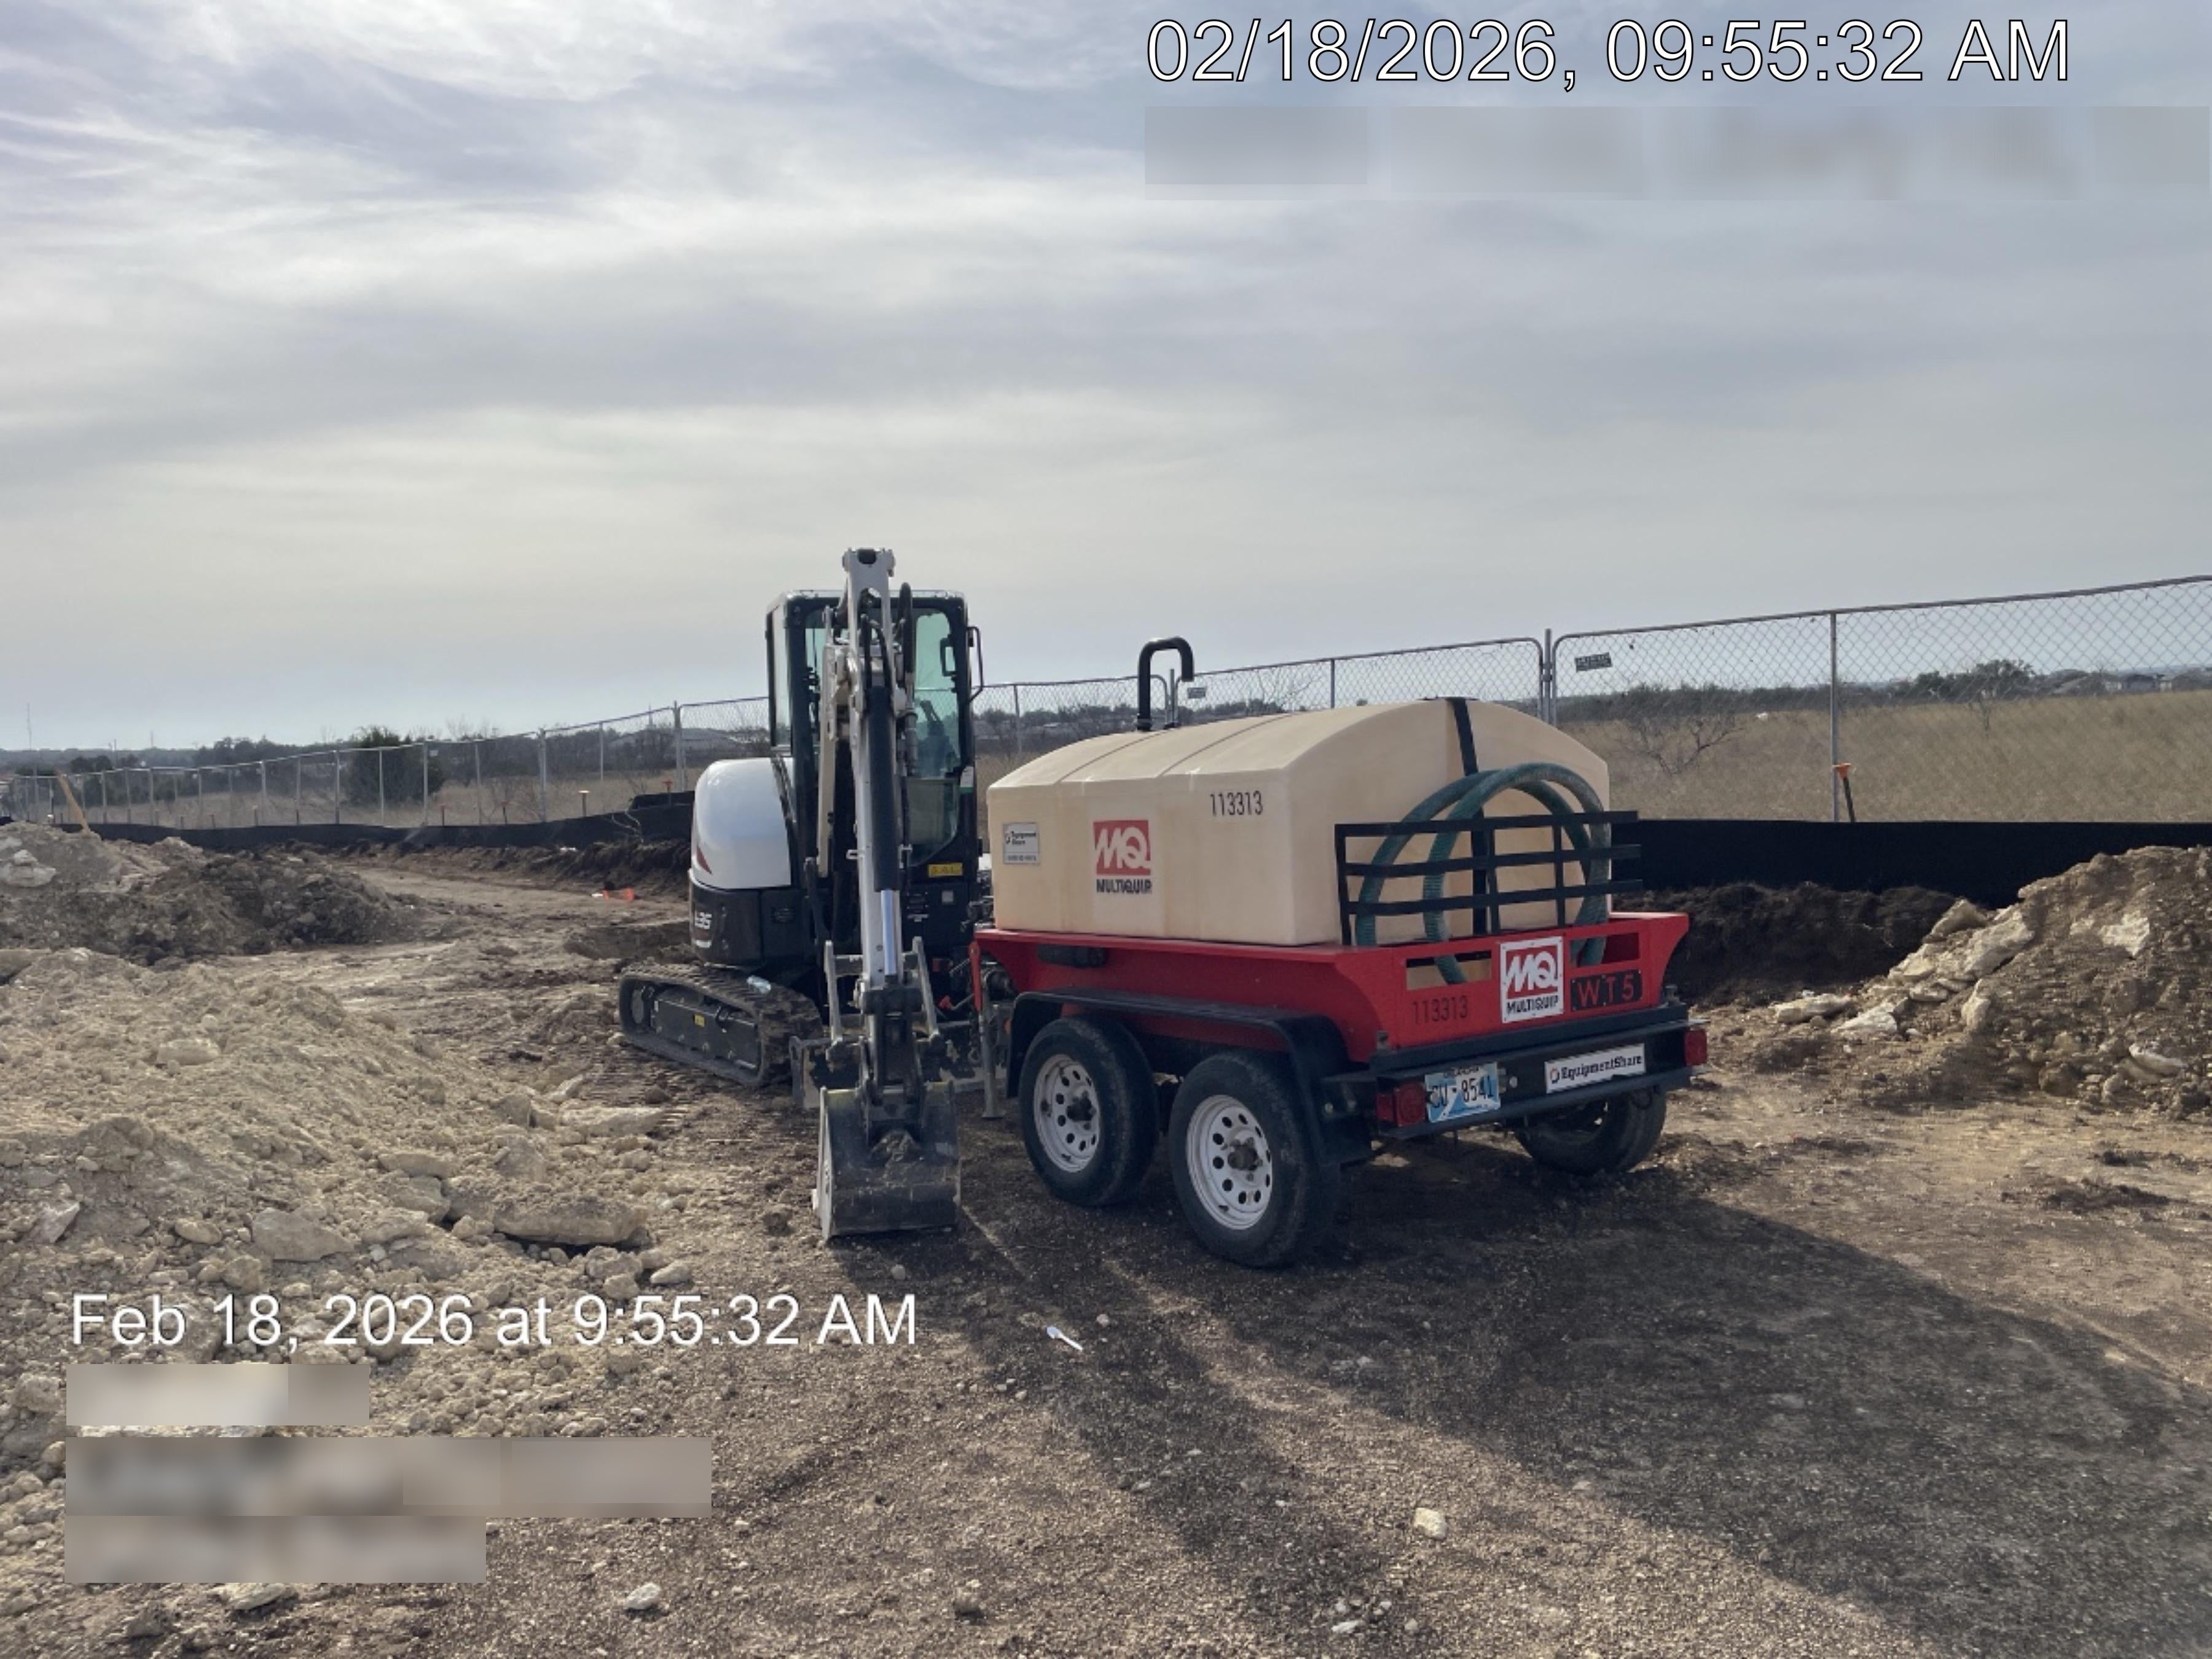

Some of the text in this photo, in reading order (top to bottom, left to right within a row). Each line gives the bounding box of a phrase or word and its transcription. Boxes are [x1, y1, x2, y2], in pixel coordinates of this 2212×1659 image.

[1210, 790, 1263, 816] 113313
[1094, 825, 1151, 870] MQ
[1096, 879, 1152, 893] MULTIQUIP
[1505, 951, 1559, 993] MQ
[1413, 995, 1469, 1024] 113313
[1507, 995, 1559, 1014] MULTIQUIP
[1561, 1055, 1642, 1081] EquipmentShare
